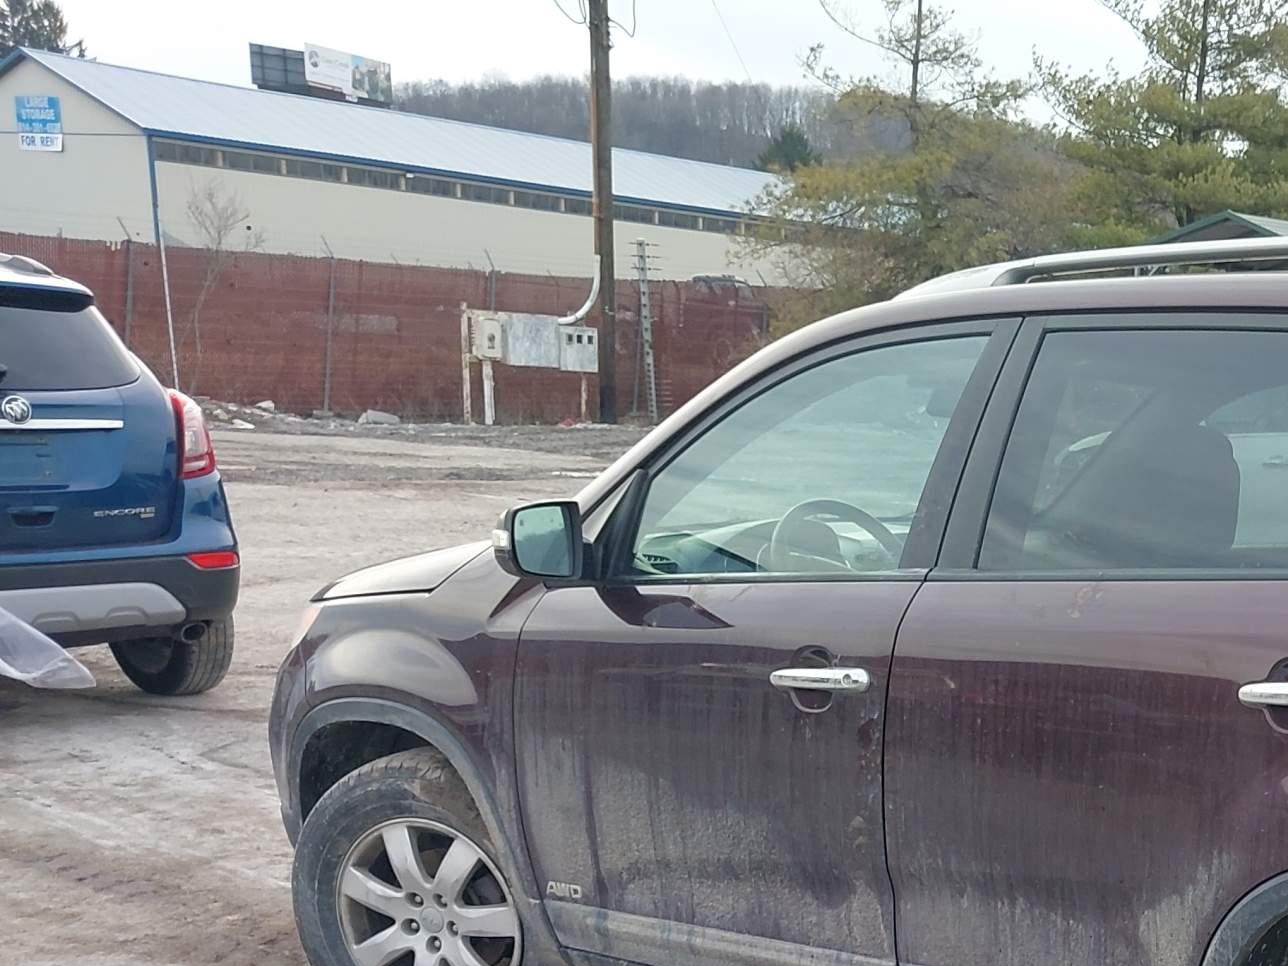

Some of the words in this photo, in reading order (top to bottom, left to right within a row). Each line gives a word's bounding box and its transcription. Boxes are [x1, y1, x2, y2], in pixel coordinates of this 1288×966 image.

[21, 135, 36, 146] FOR
[40, 135, 59, 147] RENT
[93, 506, 156, 517] ENCORE
[546, 881, 582, 898] AWD
